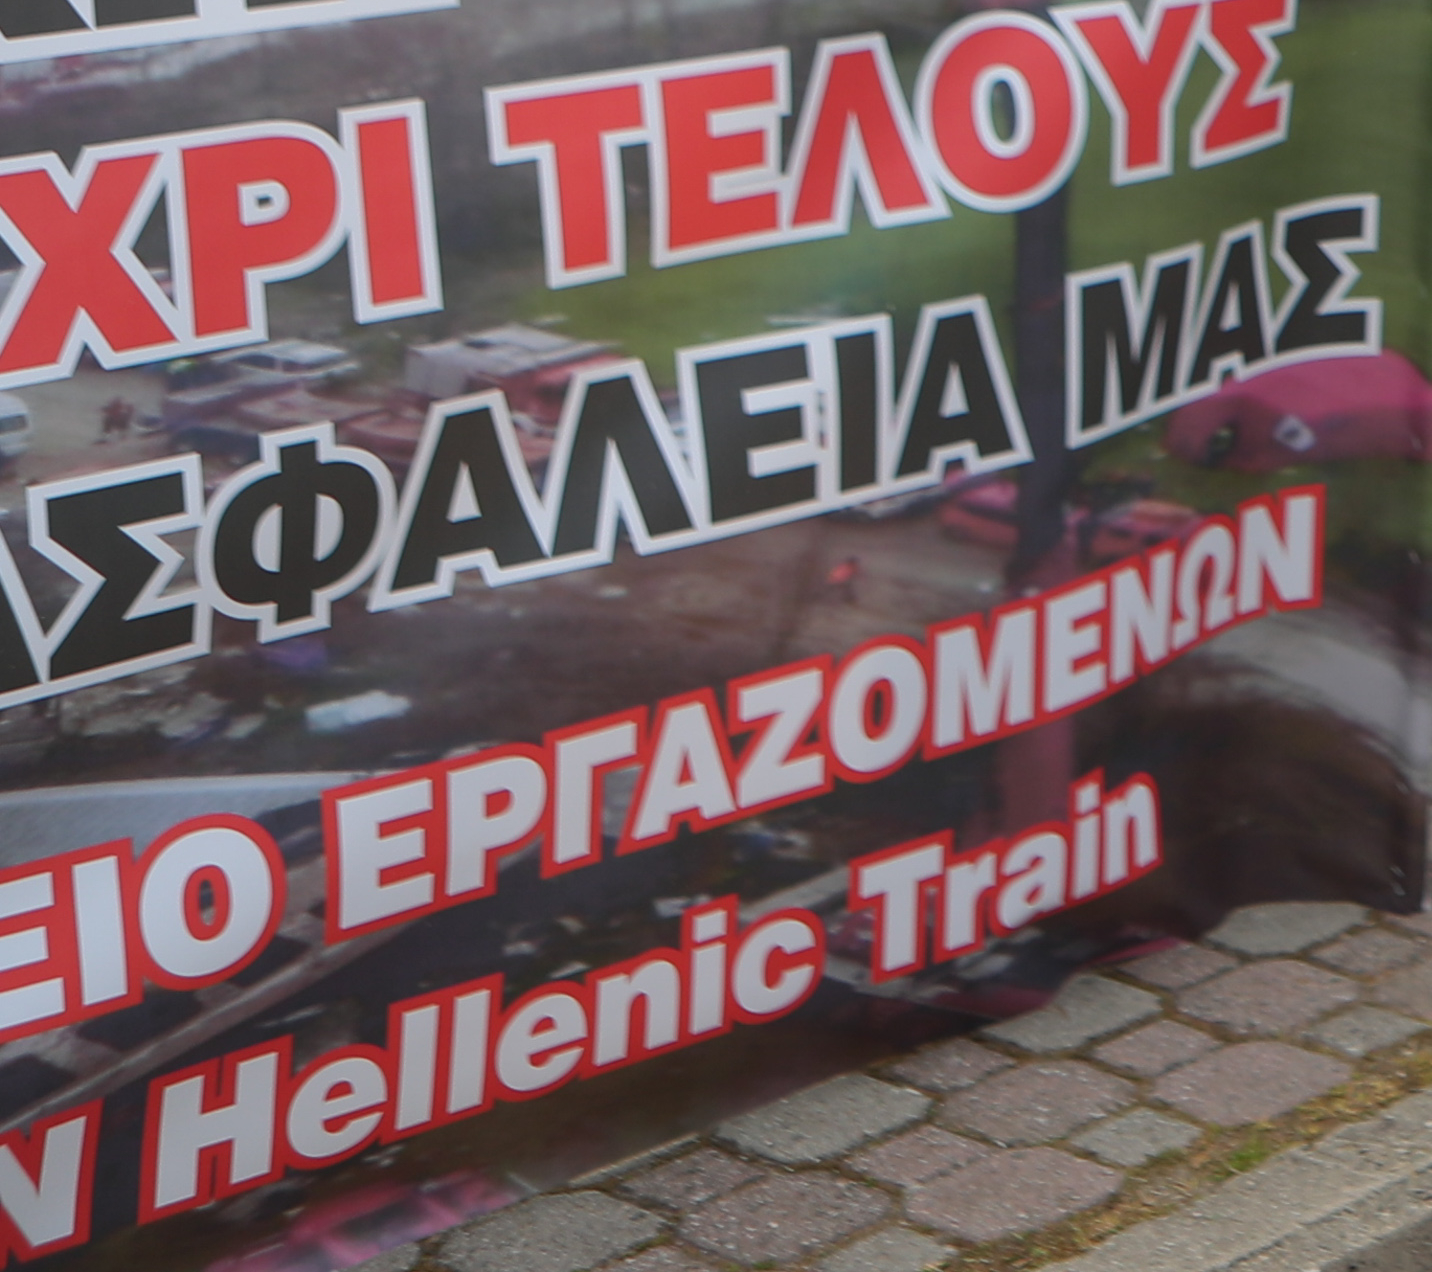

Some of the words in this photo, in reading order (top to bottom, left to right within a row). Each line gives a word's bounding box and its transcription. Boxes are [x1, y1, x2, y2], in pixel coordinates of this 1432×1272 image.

[1065, 193, 1383, 450] ΜΑΣ
[322, 485, 1325, 943] ΕΡΓΑΖΟΜΕΝΩΝ
[139, 895, 824, 1225] Hellenic
[851, 768, 1162, 983] Train
